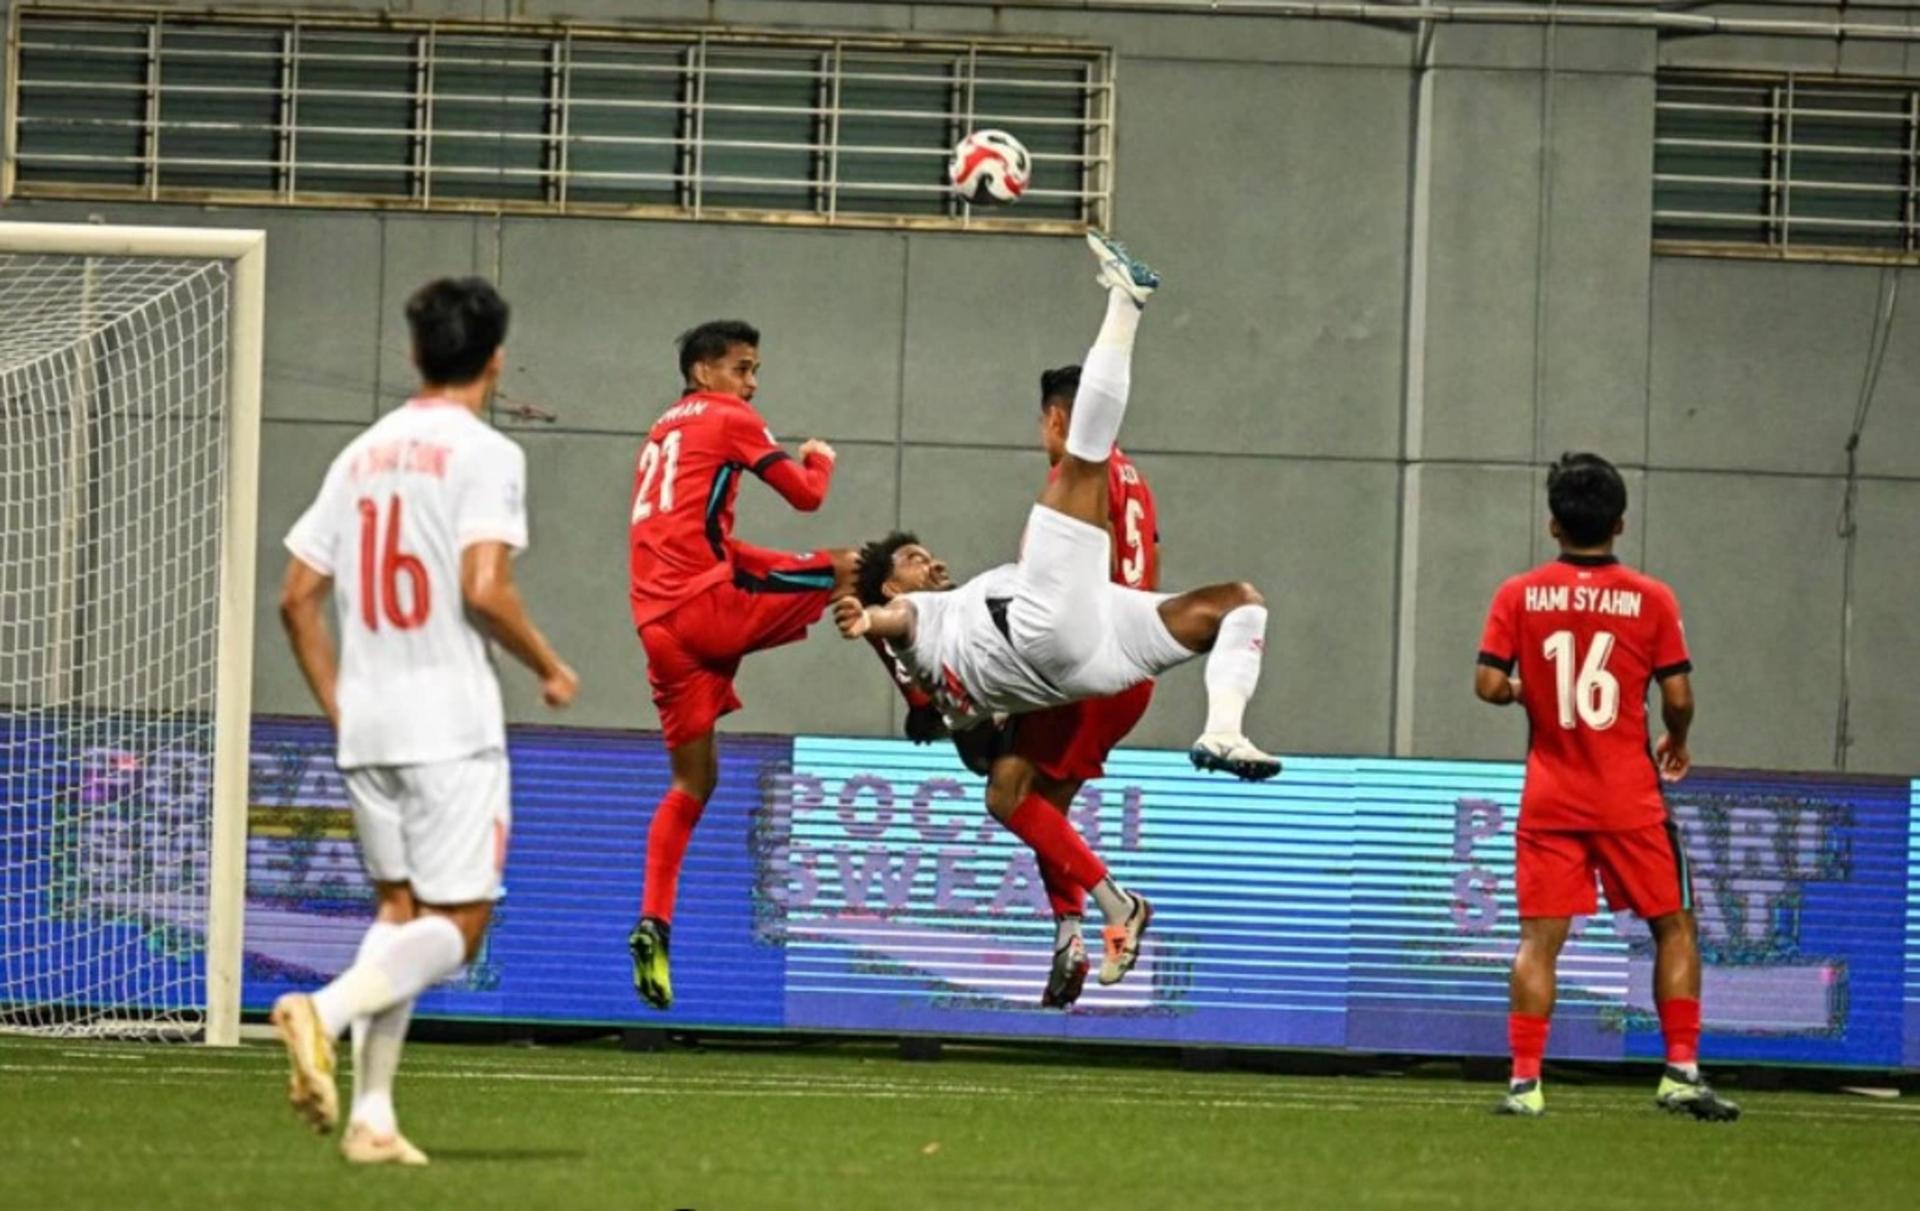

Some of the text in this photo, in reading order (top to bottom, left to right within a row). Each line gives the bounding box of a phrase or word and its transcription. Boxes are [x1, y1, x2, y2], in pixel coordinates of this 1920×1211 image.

[632, 430, 682, 526] 21
[357, 490, 432, 633] 16
[1122, 497, 1145, 585] 5
[1525, 584, 1641, 618] HAMI SYAHIN
[1543, 629, 1620, 731] 16
[770, 772, 1142, 850] POCRI
[768, 842, 1053, 917] SWEA
